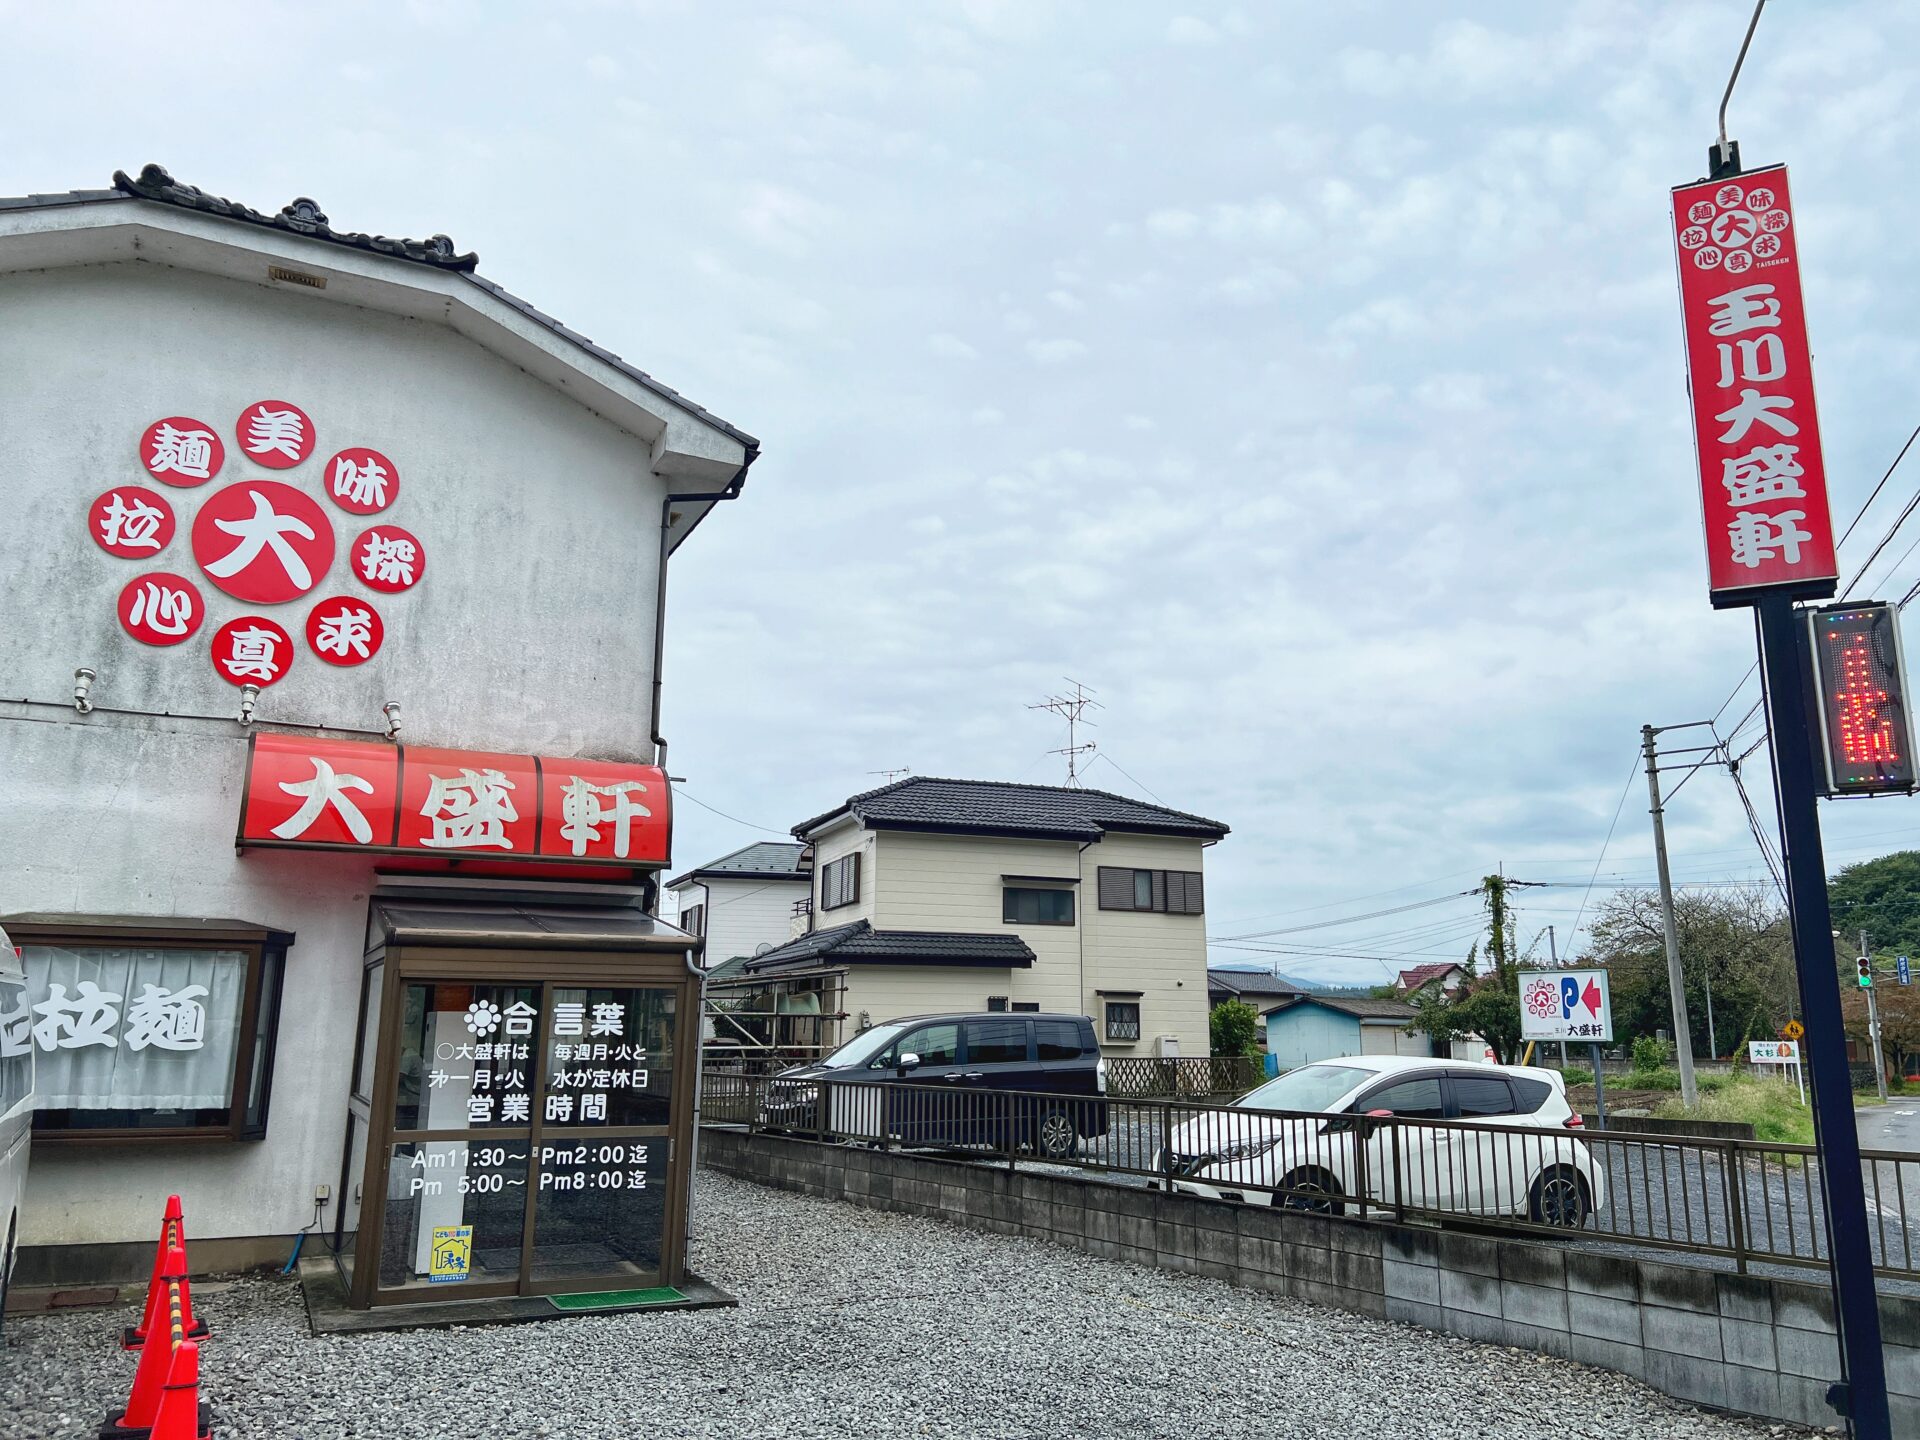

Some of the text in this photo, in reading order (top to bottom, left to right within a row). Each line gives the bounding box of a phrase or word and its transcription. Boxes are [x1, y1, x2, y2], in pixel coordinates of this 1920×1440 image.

[1684, 229, 1705, 247] 拉
[1716, 214, 1752, 243] 大
[1720, 187, 1786, 255] 美 味 探 求
[1698, 249, 1719, 266] 心
[1707, 284, 1813, 568] 玉川大盛軒
[100, 493, 164, 549] 拉
[204, 490, 315, 590] 大
[246, 406, 416, 658] 美 味 探 求
[129, 582, 192, 635] 心
[222, 626, 282, 681] 真
[270, 756, 652, 858] 大盛軒
[1567, 1023, 1603, 1037] 大盛軒
[552, 1069, 648, 1089] 水が定休日
